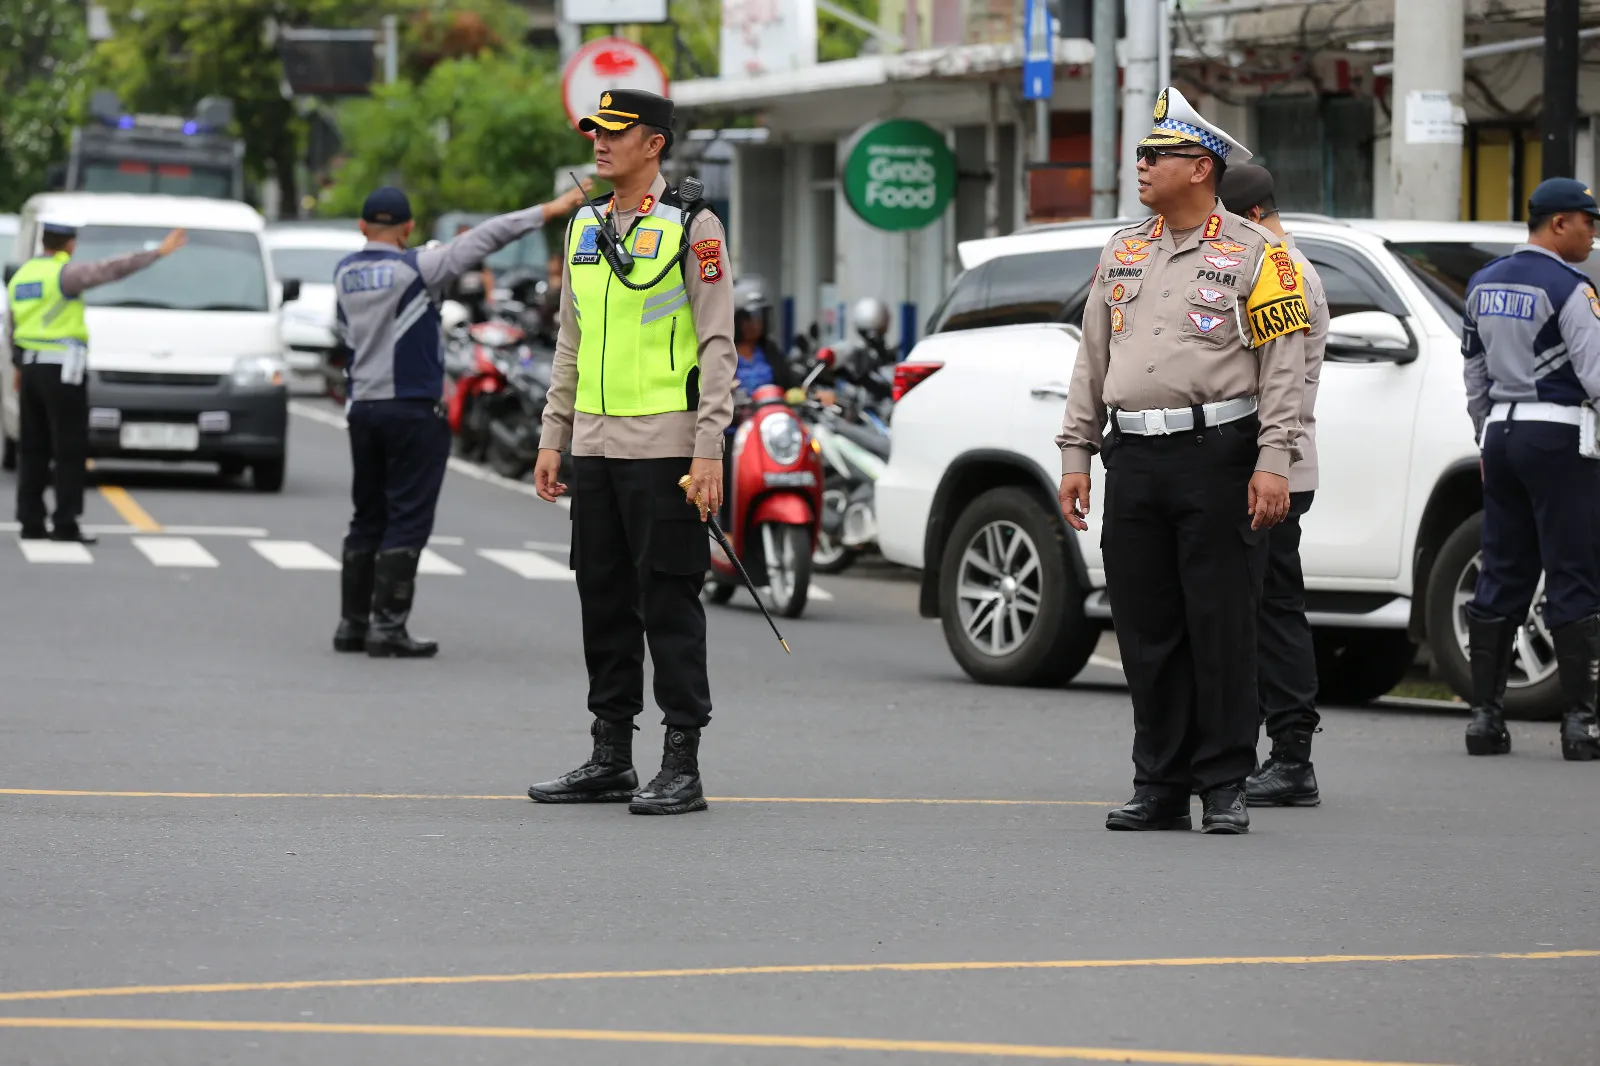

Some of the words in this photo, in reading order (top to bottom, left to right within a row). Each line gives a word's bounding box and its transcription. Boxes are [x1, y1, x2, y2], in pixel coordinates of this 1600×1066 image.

[867, 157, 936, 183] Grab
[865, 181, 937, 210] Food
[1196, 269, 1237, 287] POLRI
[1479, 289, 1535, 319] DISHUB
